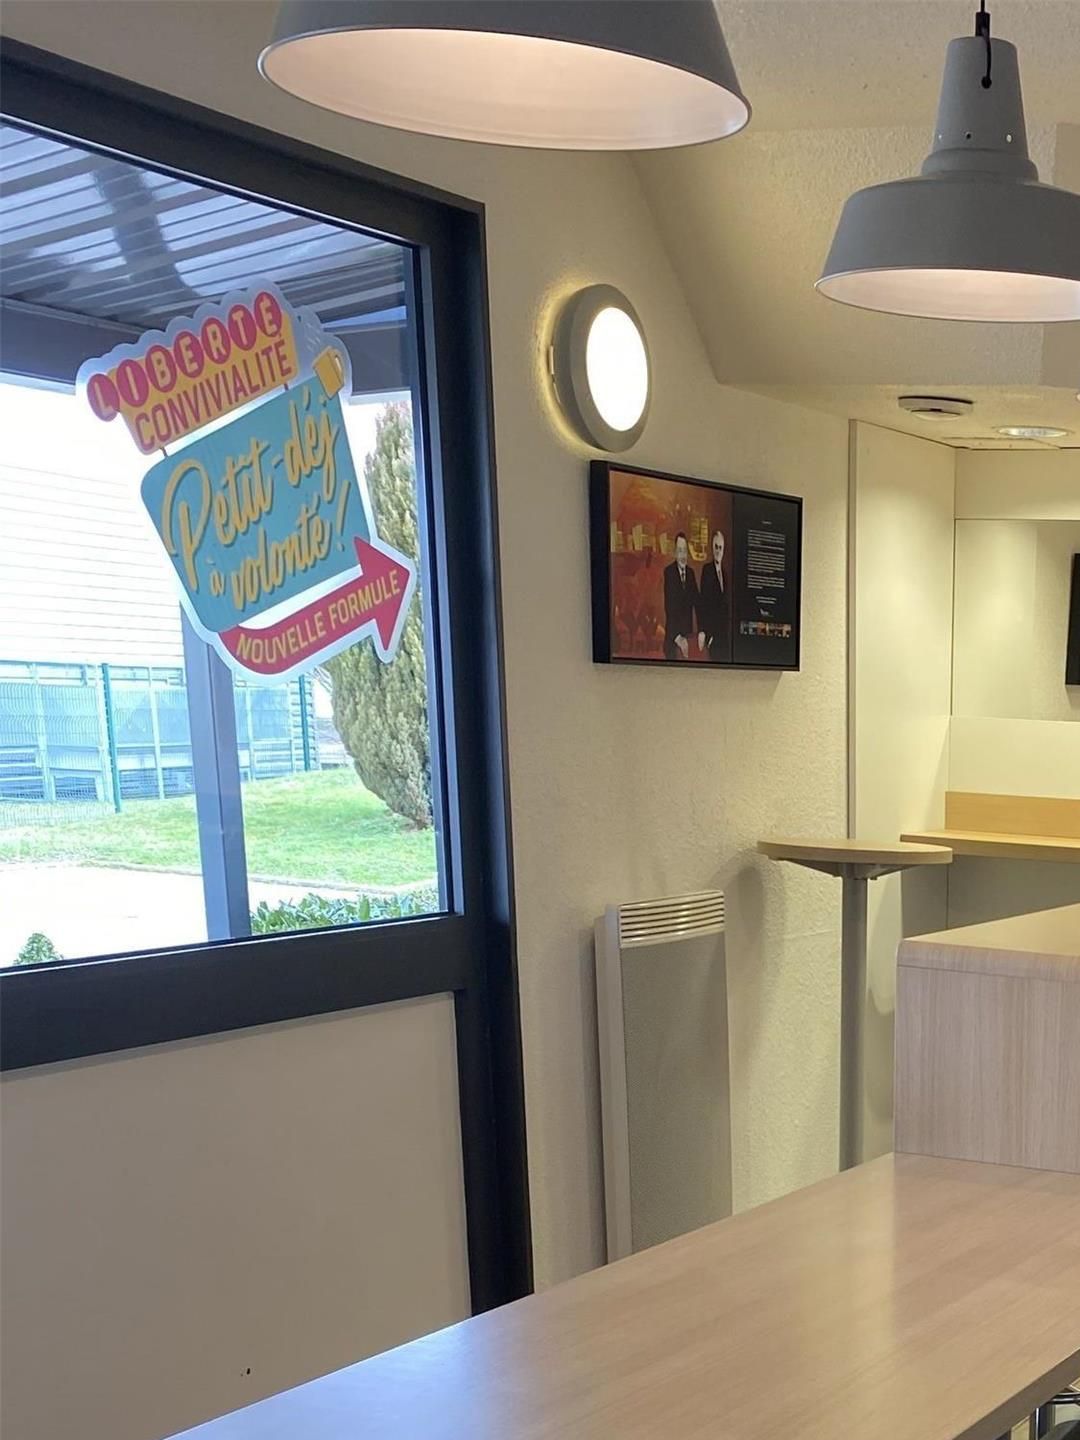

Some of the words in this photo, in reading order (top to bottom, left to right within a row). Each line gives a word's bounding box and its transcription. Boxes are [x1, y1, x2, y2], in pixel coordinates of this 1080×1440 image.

[92, 294, 278, 412] LIBERTÉ
[134, 333, 292, 453] CONVIVIALITÉ
[161, 386, 339, 595] Petit-déj
[206, 556, 226, 597] à
[237, 611, 327, 664] NOUVELLE
[328, 569, 401, 631] FORMULE
